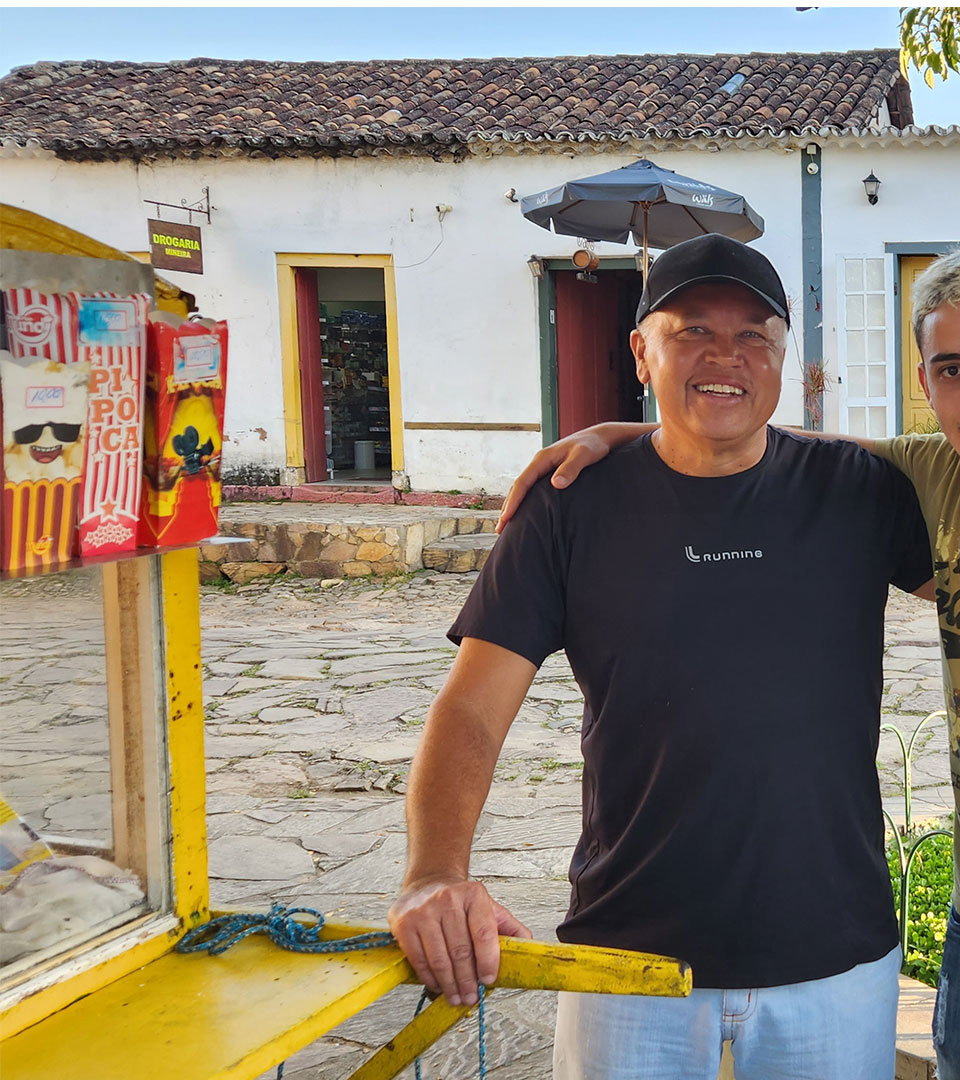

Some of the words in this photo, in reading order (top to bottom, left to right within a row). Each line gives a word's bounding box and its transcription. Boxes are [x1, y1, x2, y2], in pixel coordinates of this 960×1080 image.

[153, 233, 200, 251] DROGARIA
[165, 248, 192, 258] MINEIRA
[88, 368, 122, 393] PI
[92, 397, 135, 423] PO
[102, 426, 139, 452] CA
